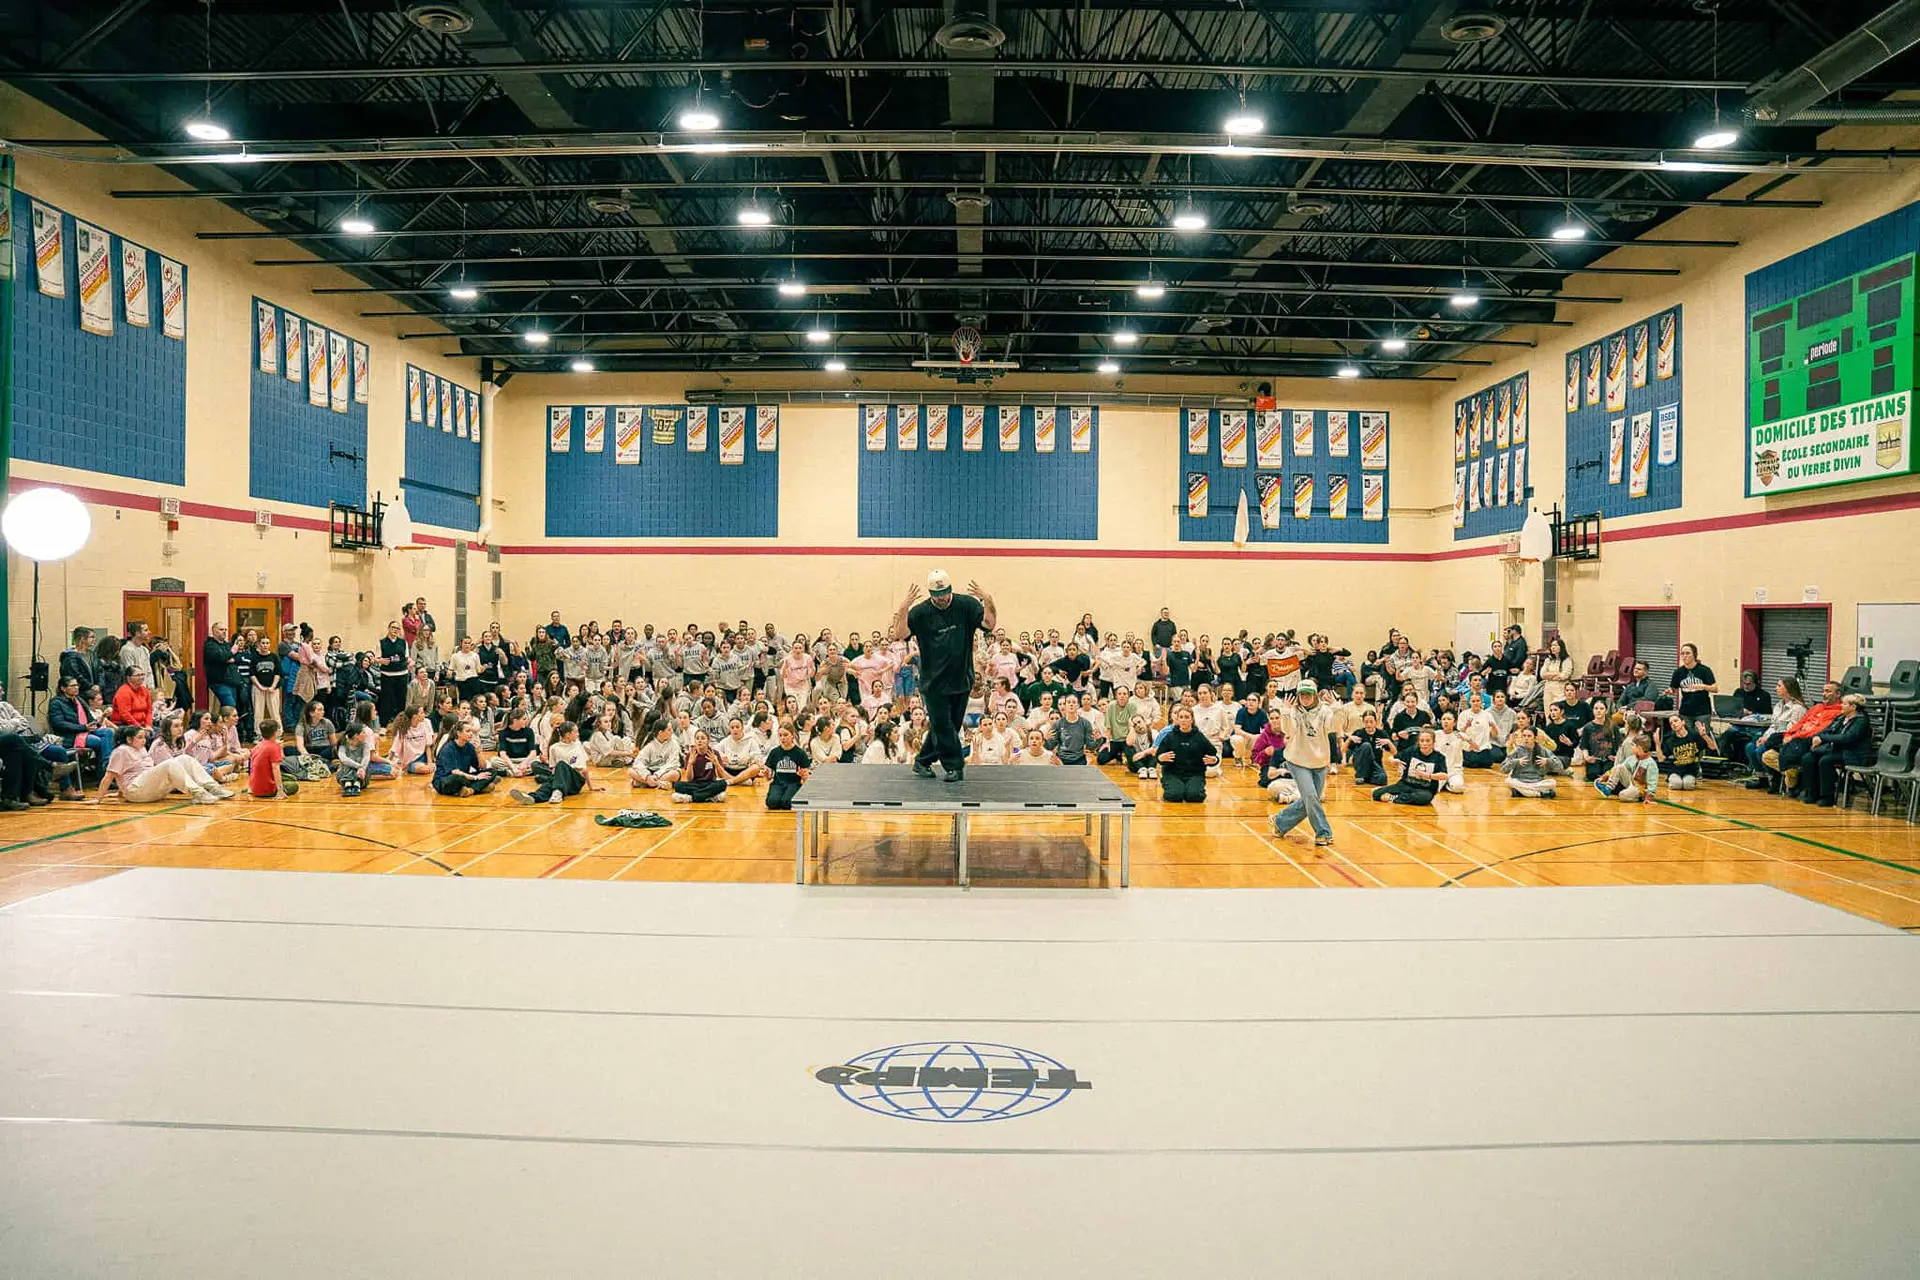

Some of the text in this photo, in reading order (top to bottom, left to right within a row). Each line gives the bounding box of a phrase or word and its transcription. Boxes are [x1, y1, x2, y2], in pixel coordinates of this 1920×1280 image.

[1756, 416, 1816, 446] DOMICILE
[1820, 409, 1846, 433] DES
[1851, 395, 1906, 426] TITANS
[1810, 434, 1869, 457] SECONDAIRE
[1787, 455, 1861, 479] DU VERBE DIVIN
[816, 1065, 1093, 1090] TEMPO
